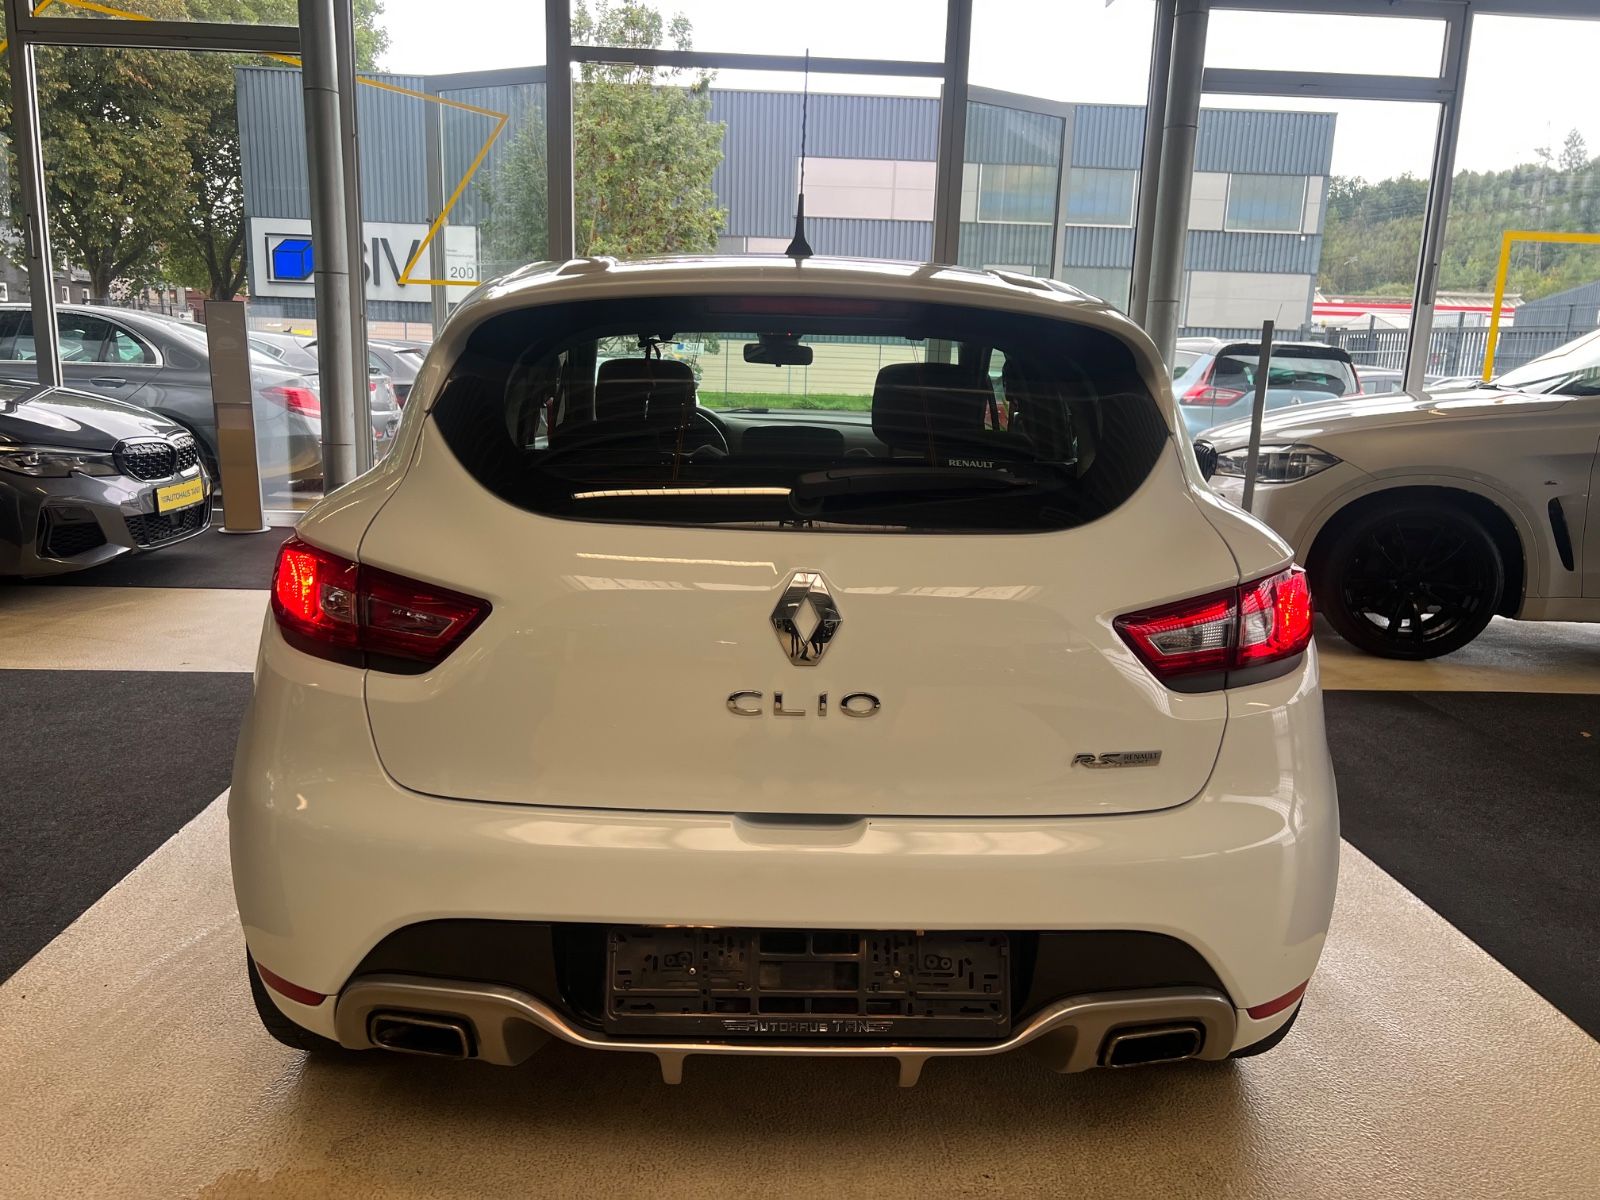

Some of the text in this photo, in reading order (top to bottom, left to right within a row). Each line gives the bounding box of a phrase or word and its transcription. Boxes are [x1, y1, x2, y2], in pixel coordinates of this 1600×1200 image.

[363, 237, 421, 287] IV
[450, 266, 474, 279] 200
[948, 459, 995, 468] RENAULT
[726, 689, 881, 718] CLIO
[1123, 752, 1158, 761] RENAULT
[832, 1020, 870, 1033] TAN
